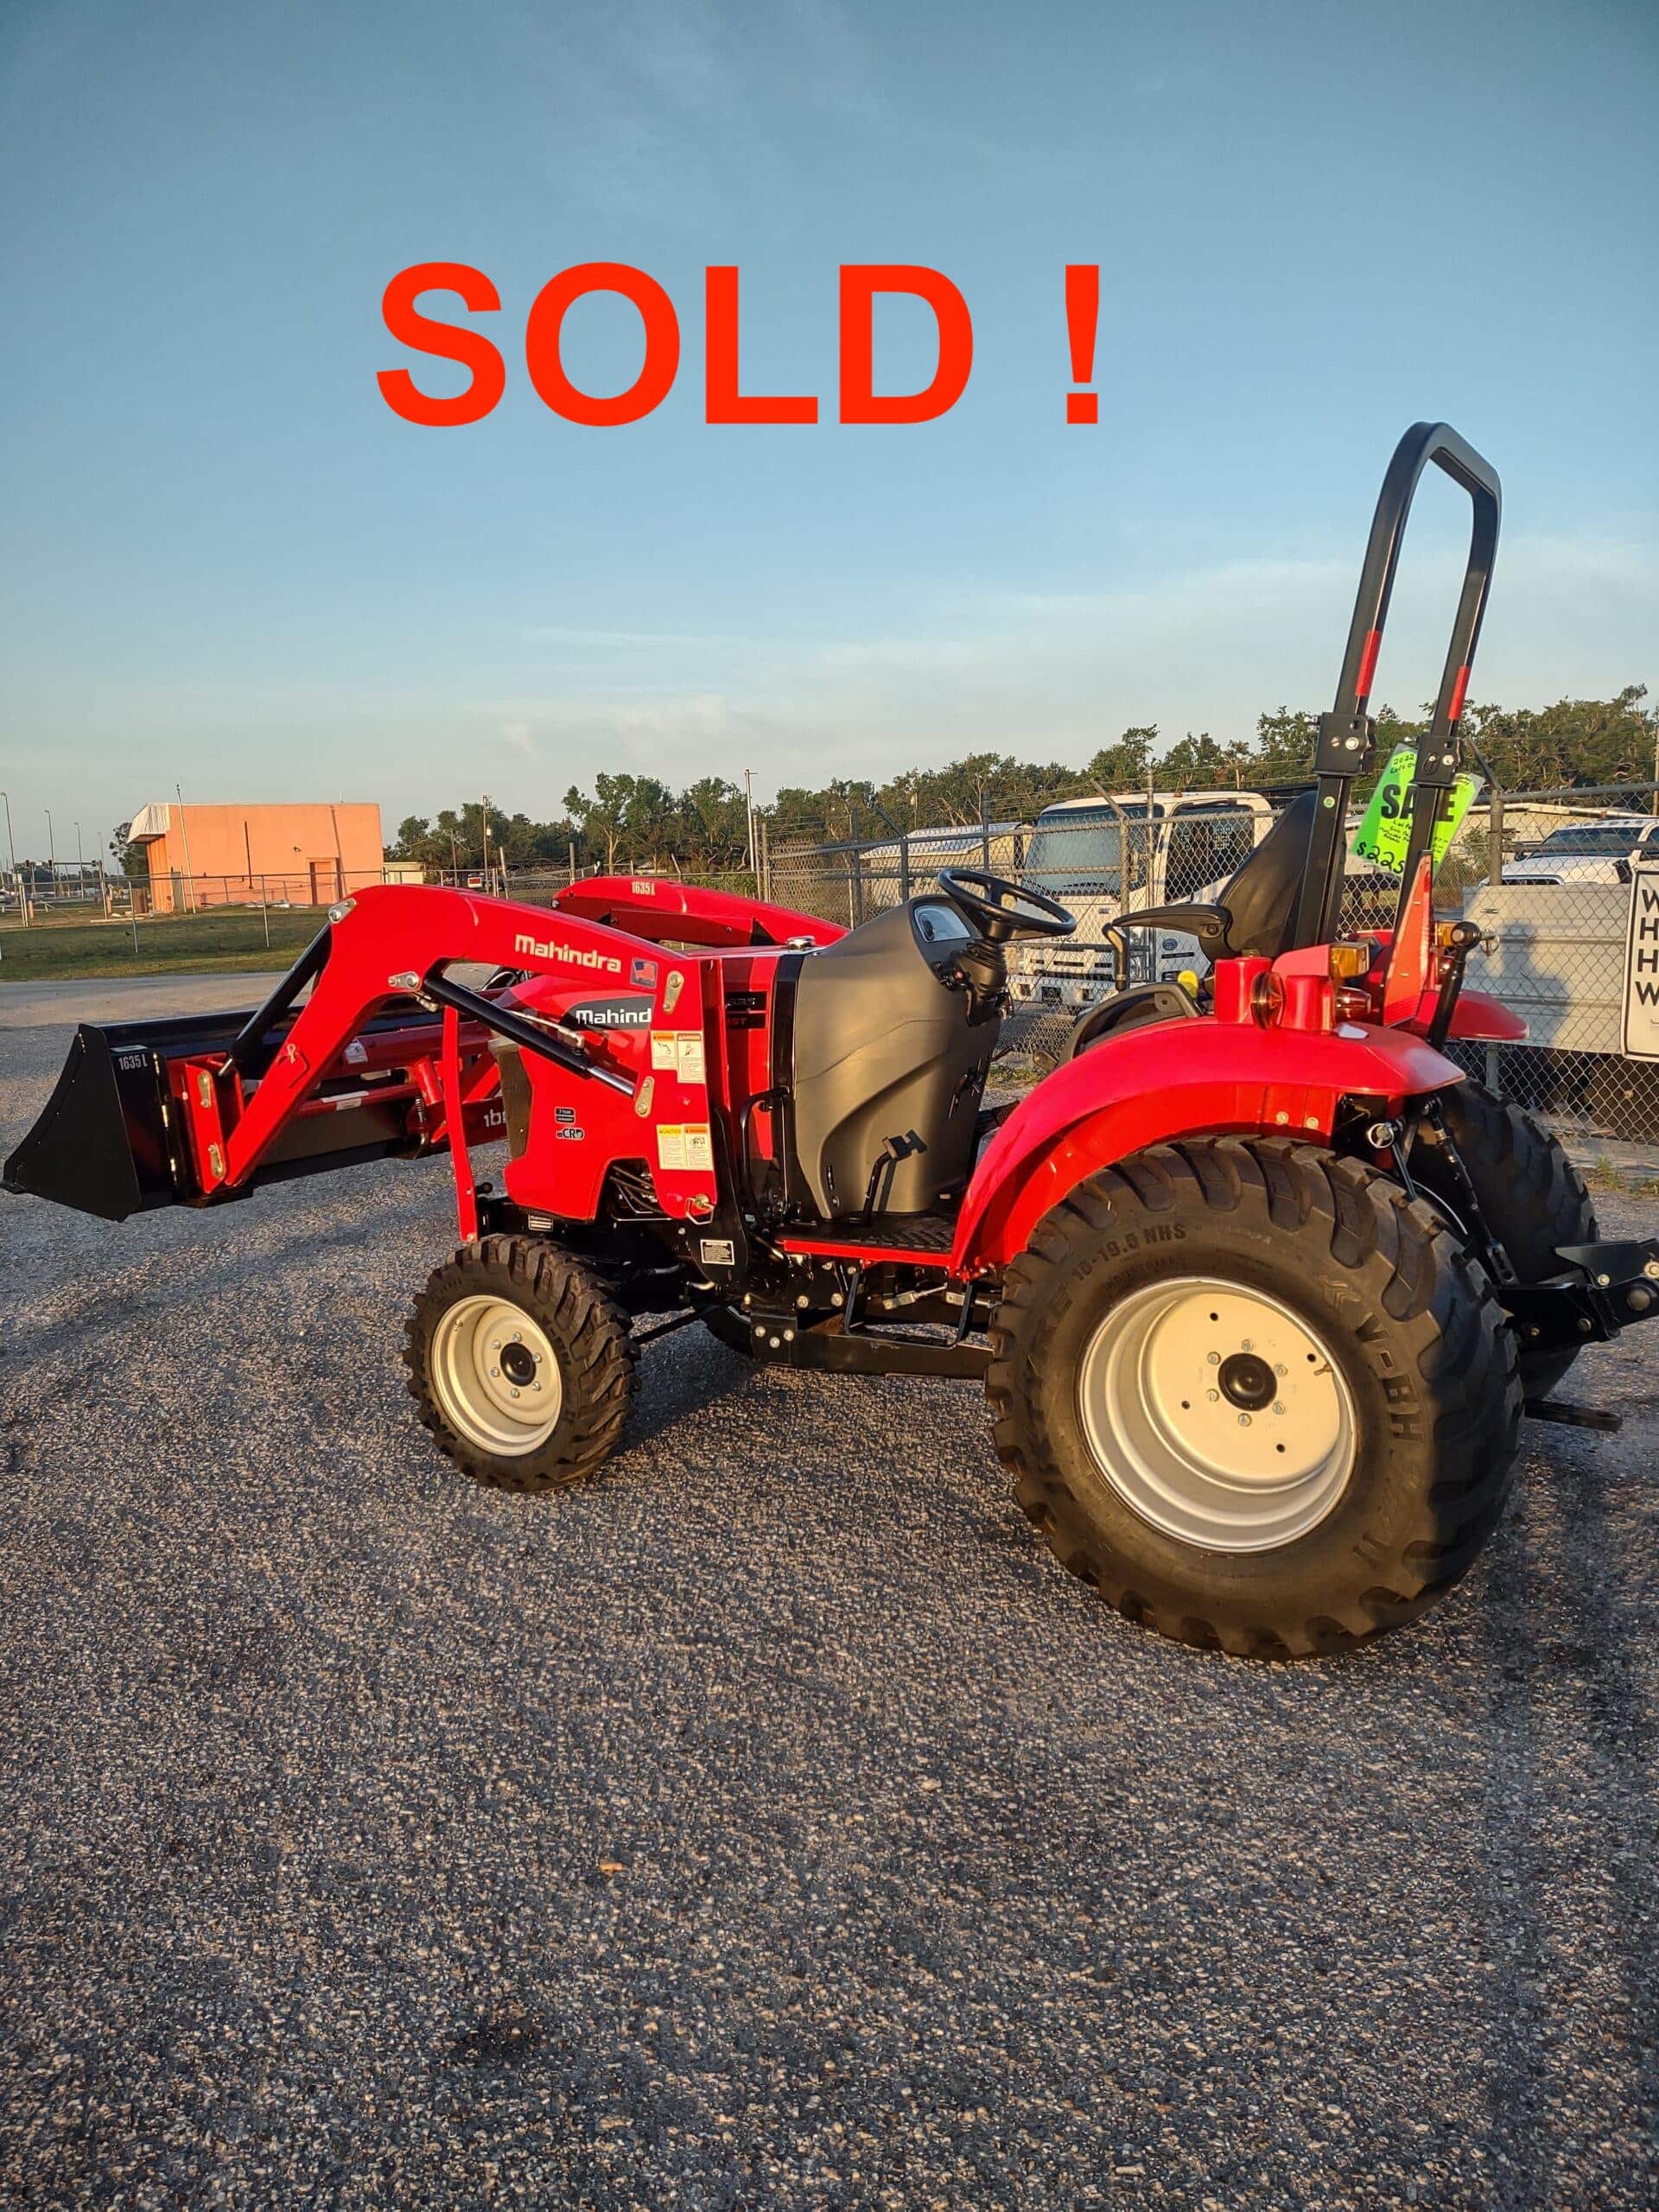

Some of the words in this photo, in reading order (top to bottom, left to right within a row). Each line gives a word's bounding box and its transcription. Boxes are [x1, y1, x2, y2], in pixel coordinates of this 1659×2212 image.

[1381, 784, 1456, 822] SAE
[515, 934, 621, 974] Mahindra
[1143, 1224, 1186, 1244] NHS
